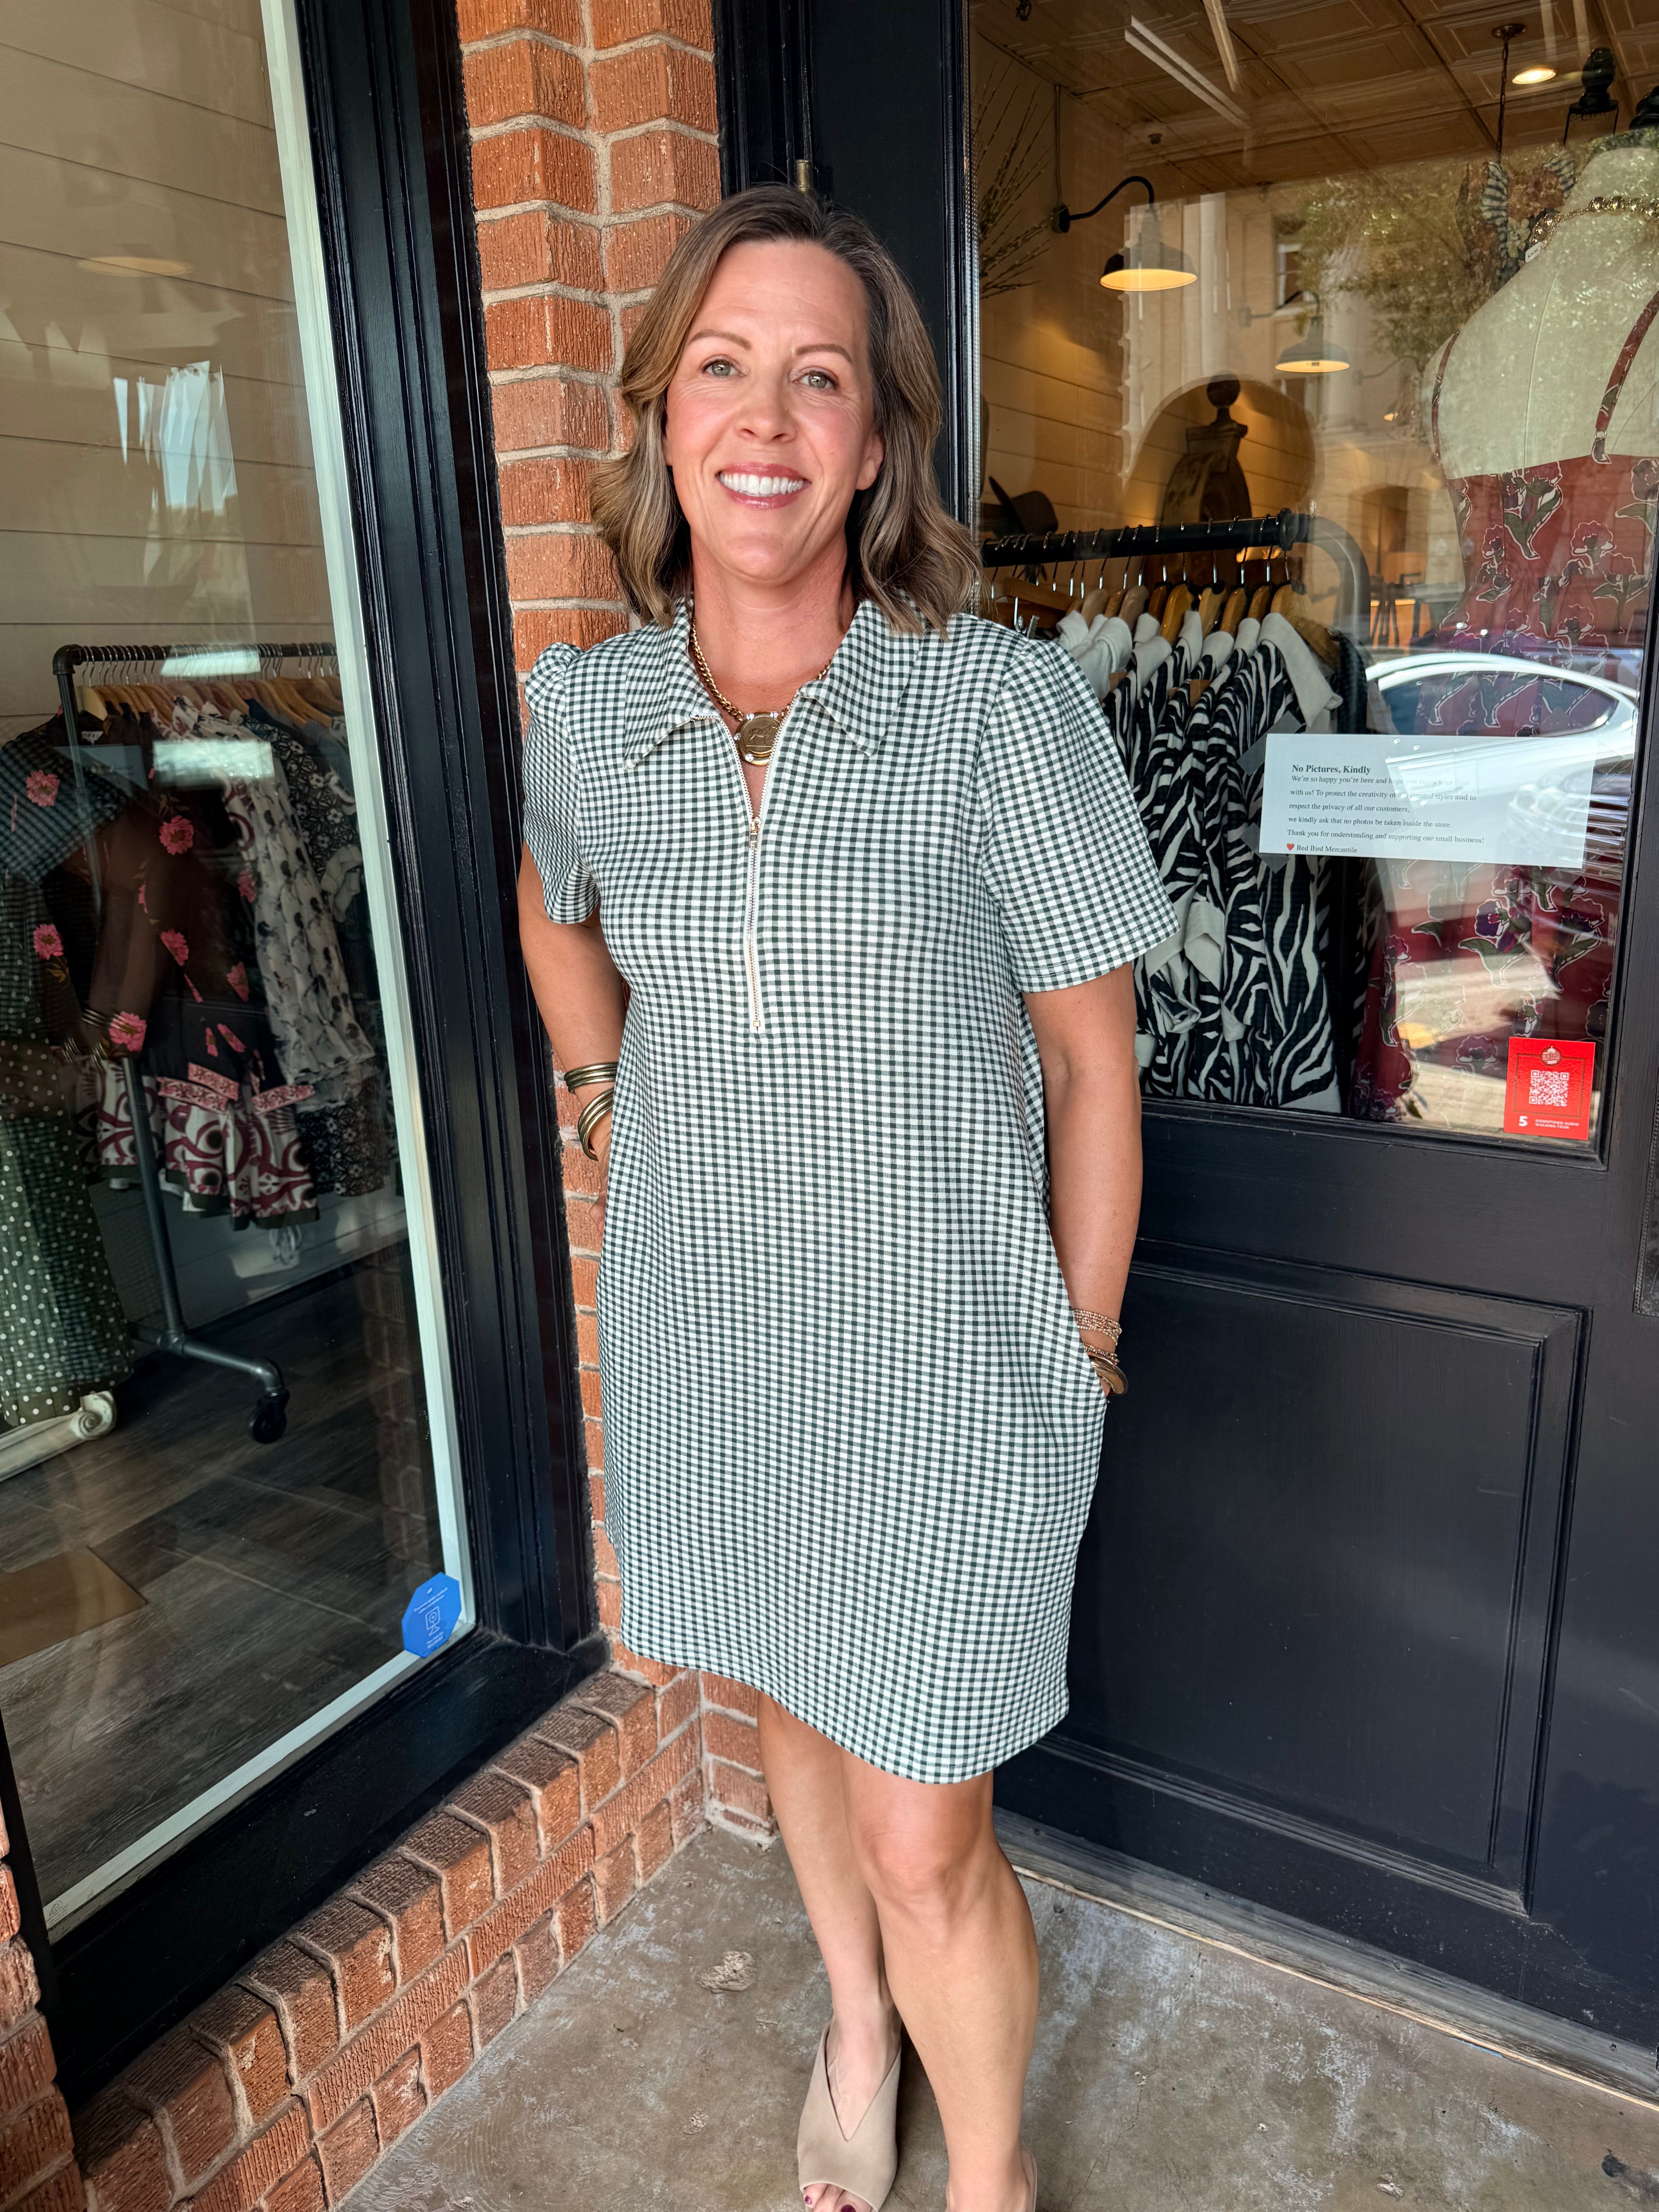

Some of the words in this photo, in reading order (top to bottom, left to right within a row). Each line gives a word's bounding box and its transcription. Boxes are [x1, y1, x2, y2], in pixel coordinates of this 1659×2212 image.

[1305, 765, 1341, 774] Pictures,
[1343, 766, 1371, 775] Kindly
[1389, 777, 1403, 785] hope
[1331, 832, 1374, 840] understanding
[1518, 1115, 1528, 1127] 5
